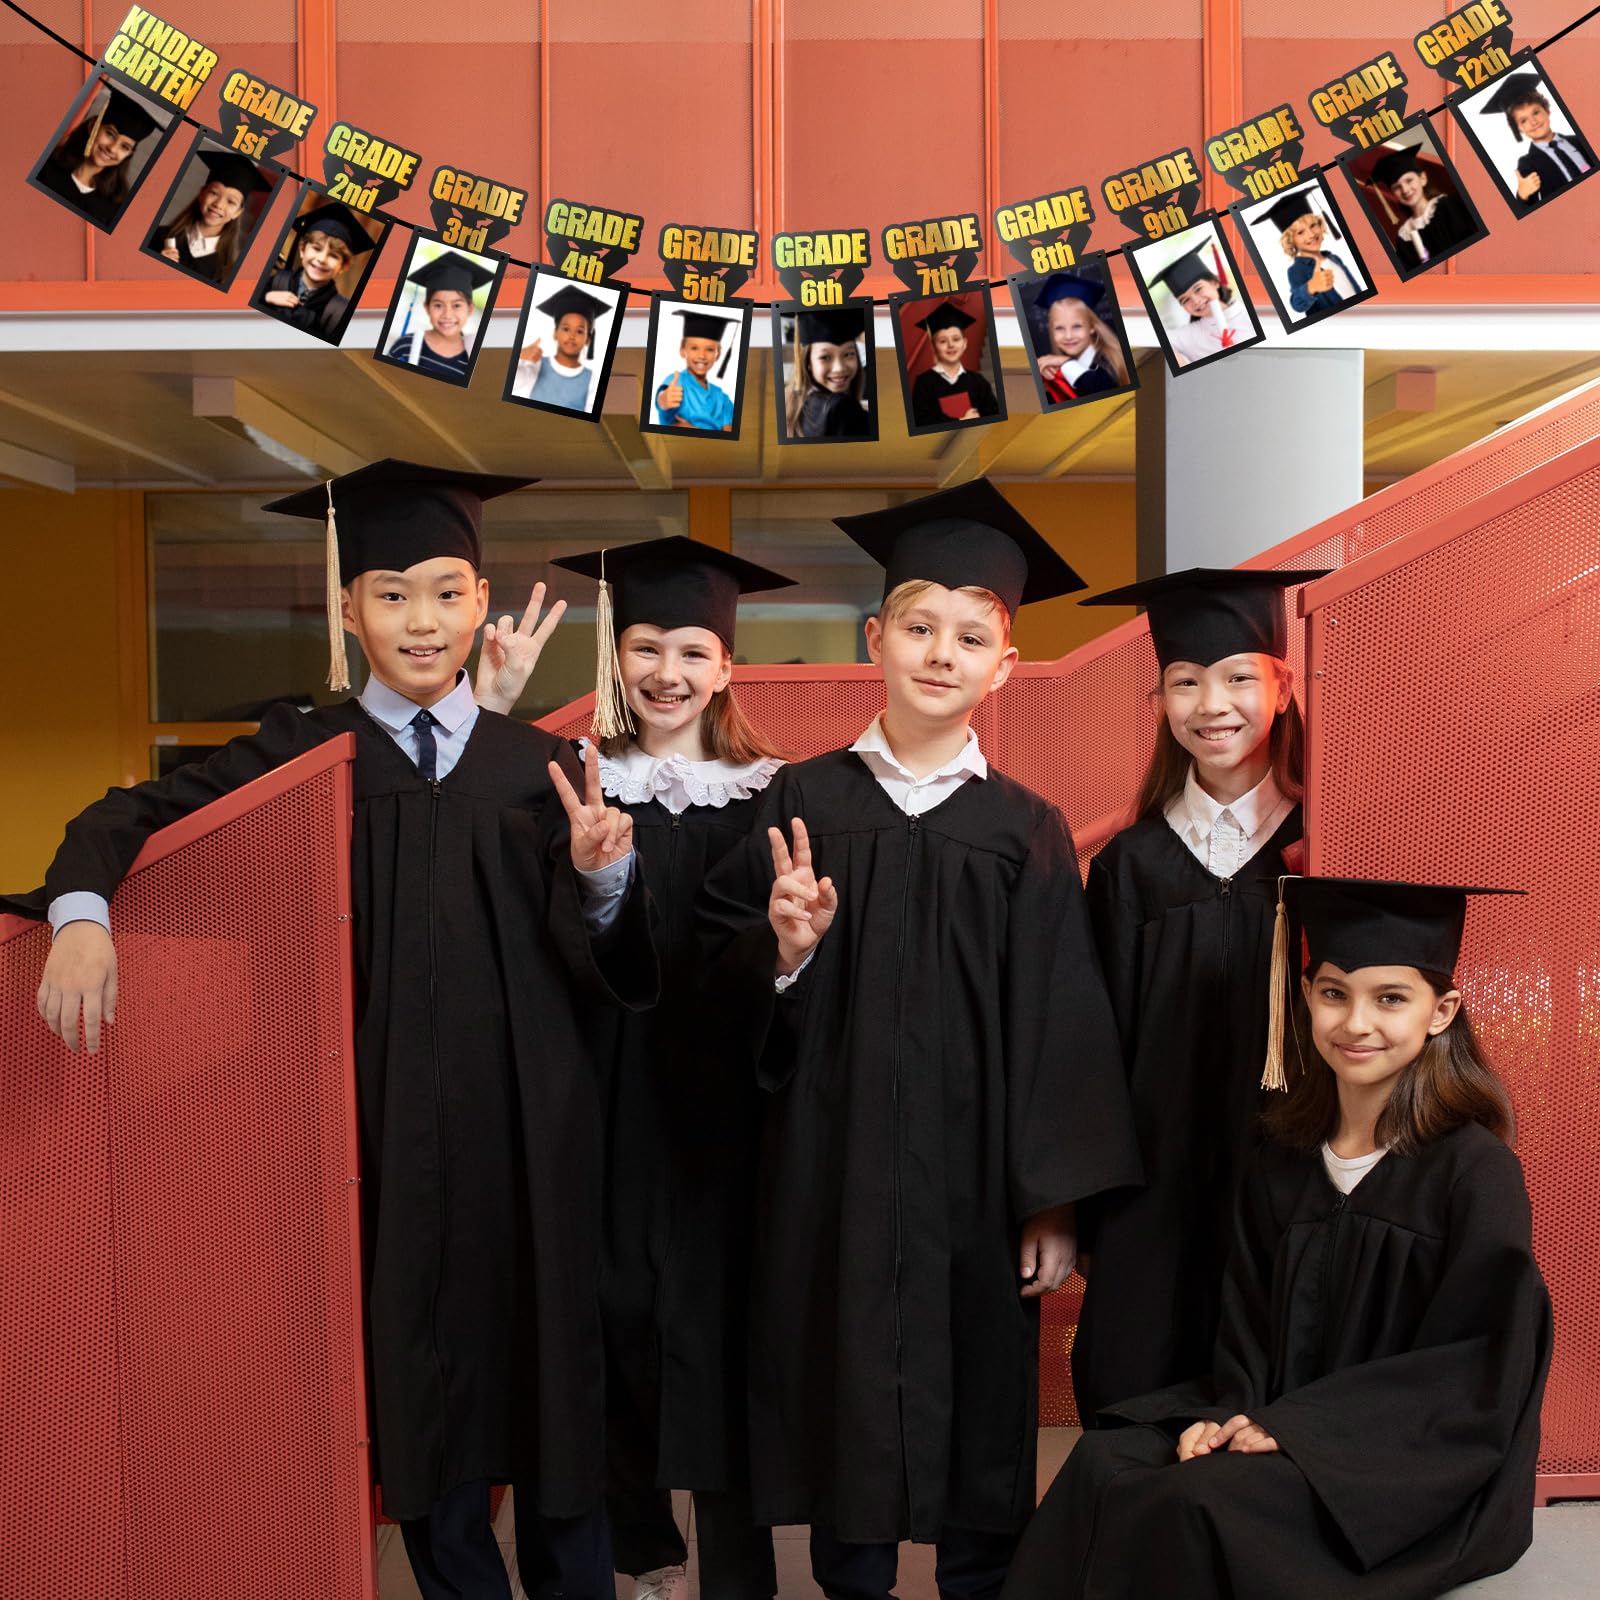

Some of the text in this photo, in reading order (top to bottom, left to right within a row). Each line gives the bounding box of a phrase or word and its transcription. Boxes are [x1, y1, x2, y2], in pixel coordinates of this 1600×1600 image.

[119, 5, 218, 82] KINDER
[1417, 0, 1508, 66] GRADE
[104, 34, 203, 111] GARTEN
[1456, 44, 1512, 90] 12th
[223, 73, 315, 137] GRADE
[1311, 56, 1403, 124] GRADE
[231, 123, 269, 160] 1st
[1208, 109, 1299, 172] GRADE
[1350, 109, 1404, 149] 11th
[327, 125, 418, 186] GRADE
[327, 172, 380, 213] 2nd
[433, 169, 525, 222] GRADE
[1104, 152, 1198, 212] GRADE
[1242, 160, 1299, 200] 10th
[441, 217, 489, 253] 3rd
[548, 203, 641, 250] GRADE
[996, 190, 1091, 242] GRADE
[1143, 203, 1190, 241] 9th
[663, 228, 756, 266] GRADE
[775, 232, 868, 268] GRADE
[886, 218, 979, 261] GRADE
[1030, 242, 1076, 274] 8th
[560, 251, 604, 284] 4th
[682, 273, 726, 303] 5th
[916, 266, 959, 296] 7th
[800, 279, 843, 307] 6th
